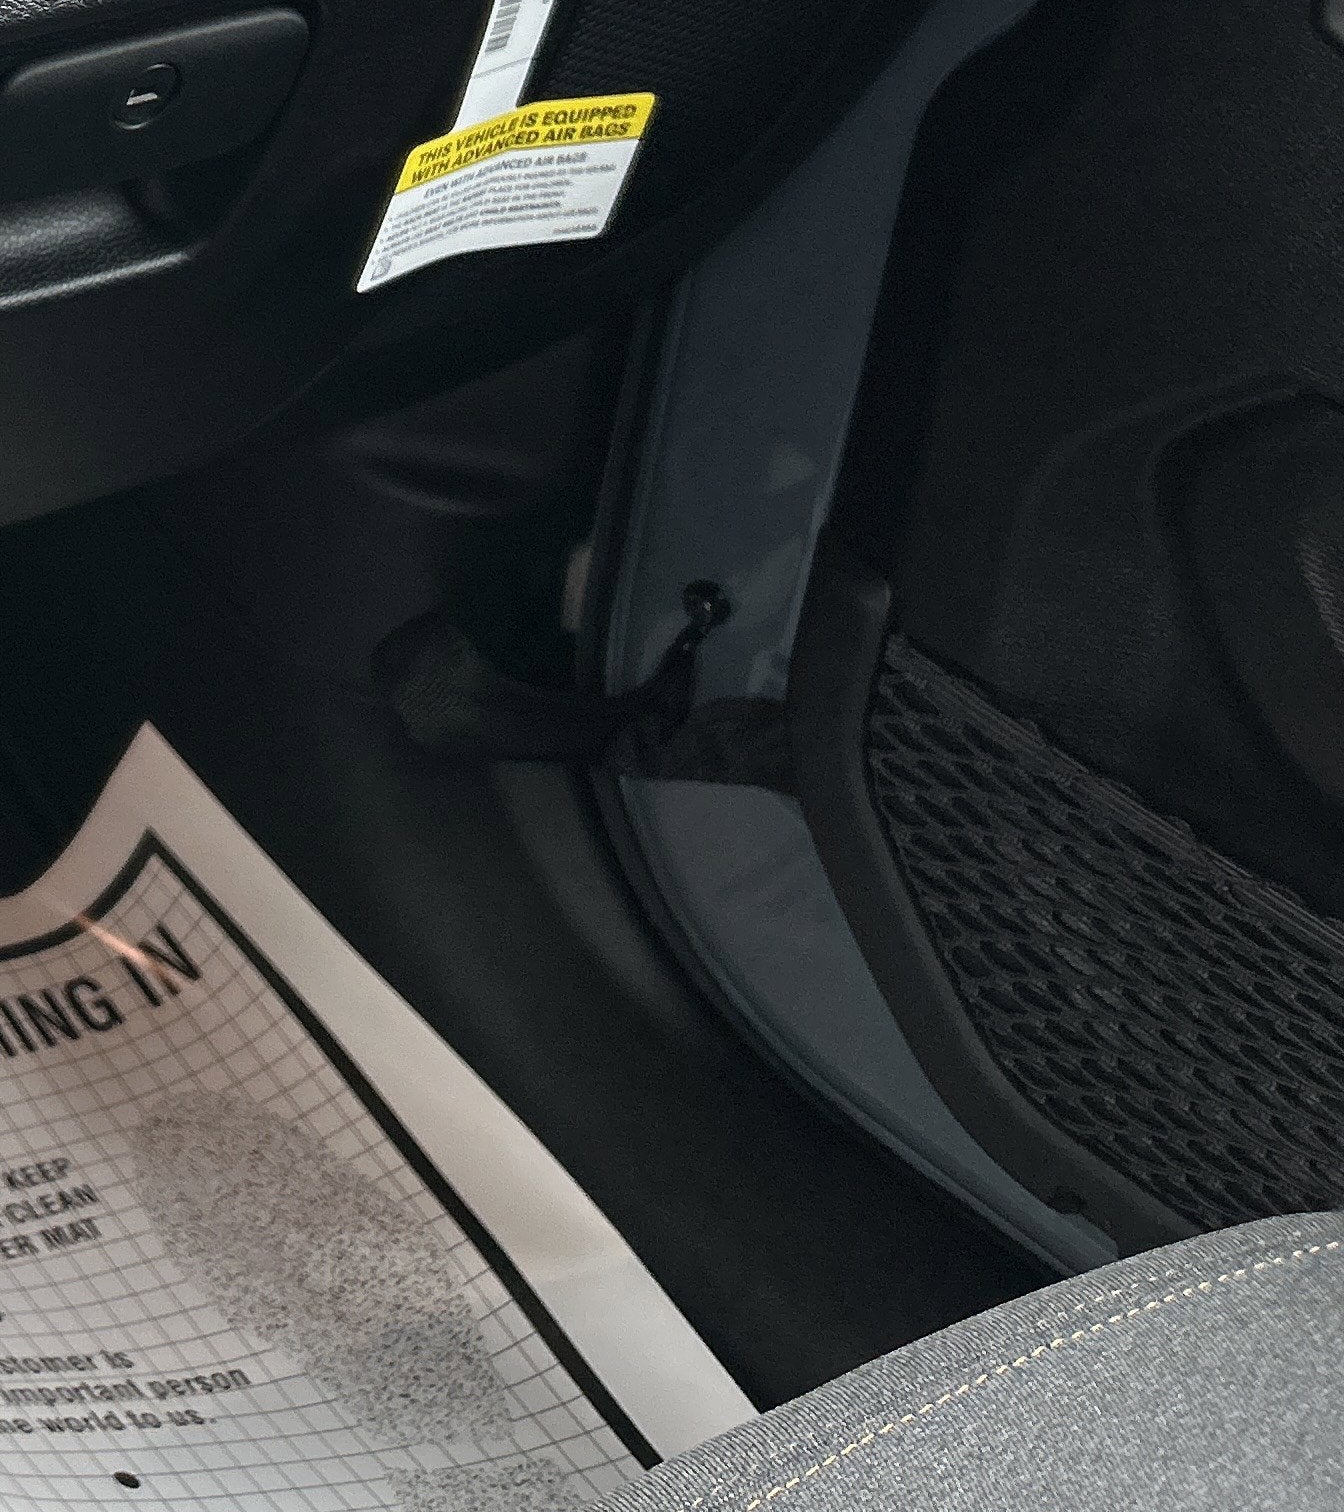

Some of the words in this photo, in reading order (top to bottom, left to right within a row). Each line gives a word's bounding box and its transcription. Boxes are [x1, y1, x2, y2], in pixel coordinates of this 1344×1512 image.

[411, 161, 450, 185] WITH
[451, 130, 541, 169] ADVANCED
[542, 125, 577, 144] AIR
[578, 121, 632, 139] BAGS
[418, 141, 452, 166] THIS
[455, 116, 519, 152] VEHICLE
[519, 111, 540, 128] IS
[542, 104, 639, 127] EQUIPPED
[129, 924, 204, 1007] IN
[5, 1156, 73, 1193] KEEP
[3, 1183, 102, 1226] CLEAN
[42, 1216, 104, 1253] MAT
[147, 1366, 254, 1402] person
[43, 1407, 123, 1435] world
[124, 1409, 162, 1432] to
[171, 1405, 218, 1428] us.
